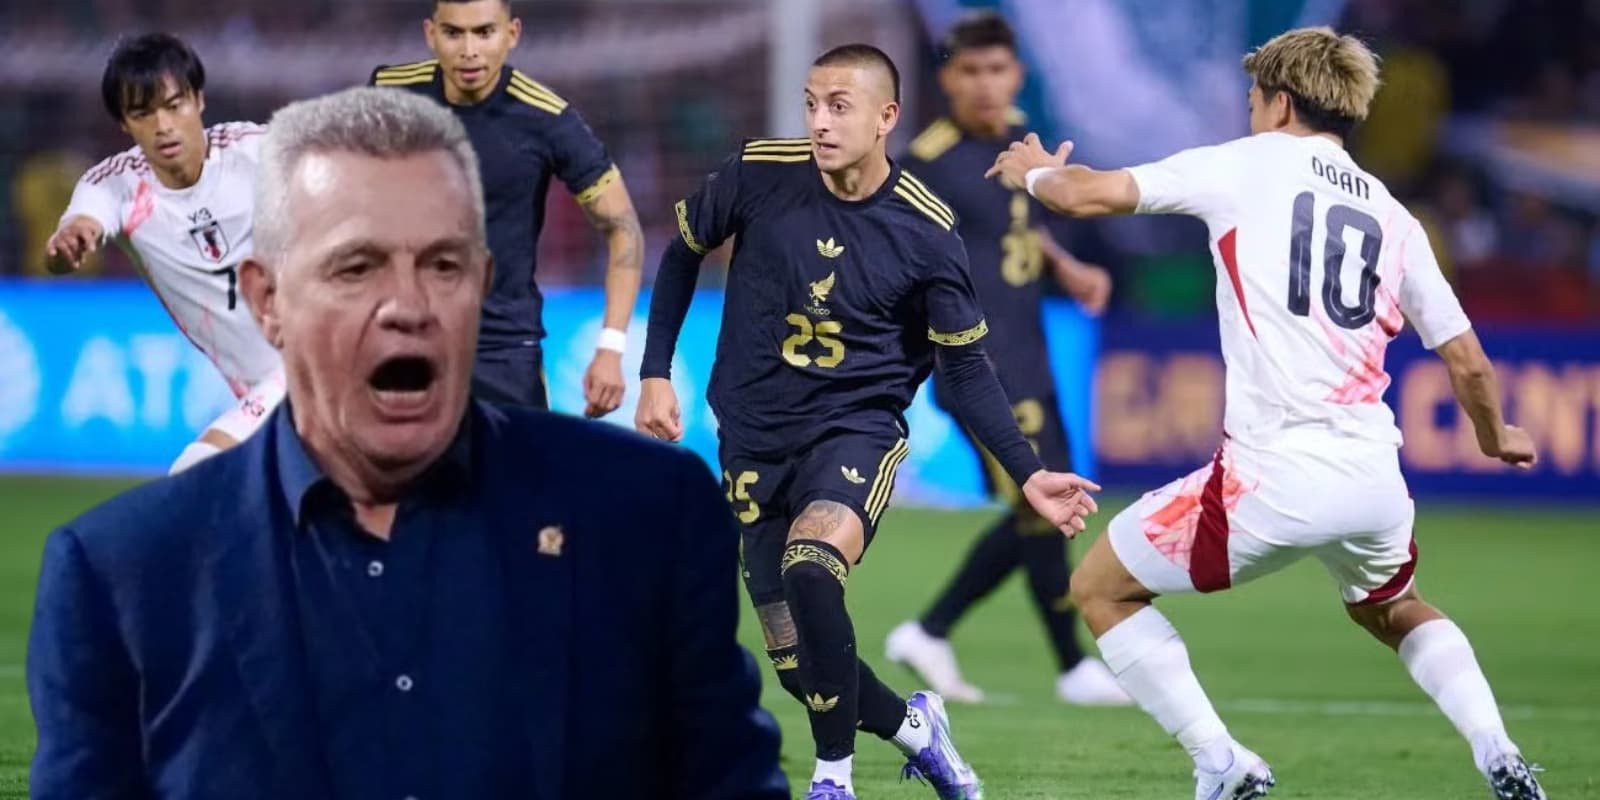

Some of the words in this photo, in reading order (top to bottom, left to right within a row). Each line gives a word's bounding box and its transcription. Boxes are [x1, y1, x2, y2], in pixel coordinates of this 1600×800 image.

[1312, 156, 1370, 200] DOAN
[1287, 190, 1383, 330] 10
[211, 265, 237, 311] 7
[782, 312, 845, 368] 25
